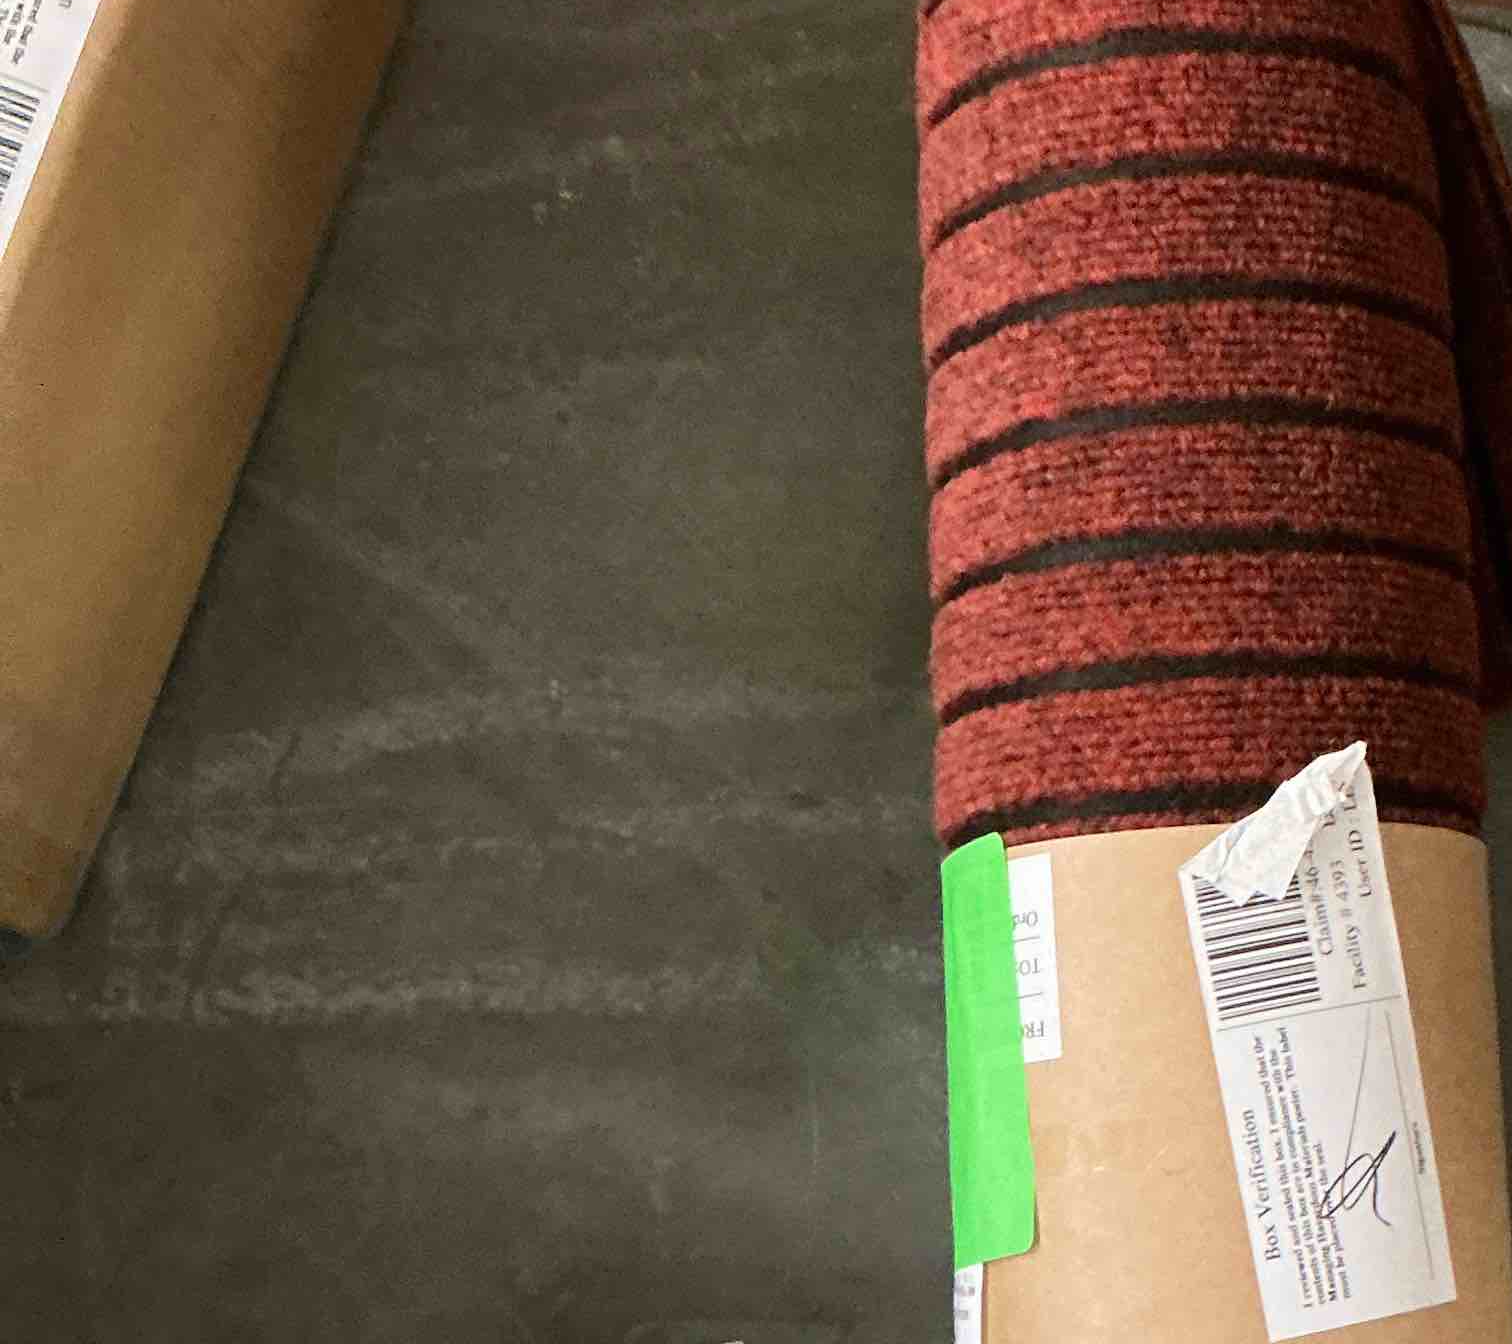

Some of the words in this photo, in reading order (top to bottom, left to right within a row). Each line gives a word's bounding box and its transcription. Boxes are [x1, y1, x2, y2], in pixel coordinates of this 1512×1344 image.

[1341, 924, 1368, 990] Facility
[1238, 1108, 1274, 1218] Verification
[1259, 1223, 1282, 1262] Box
